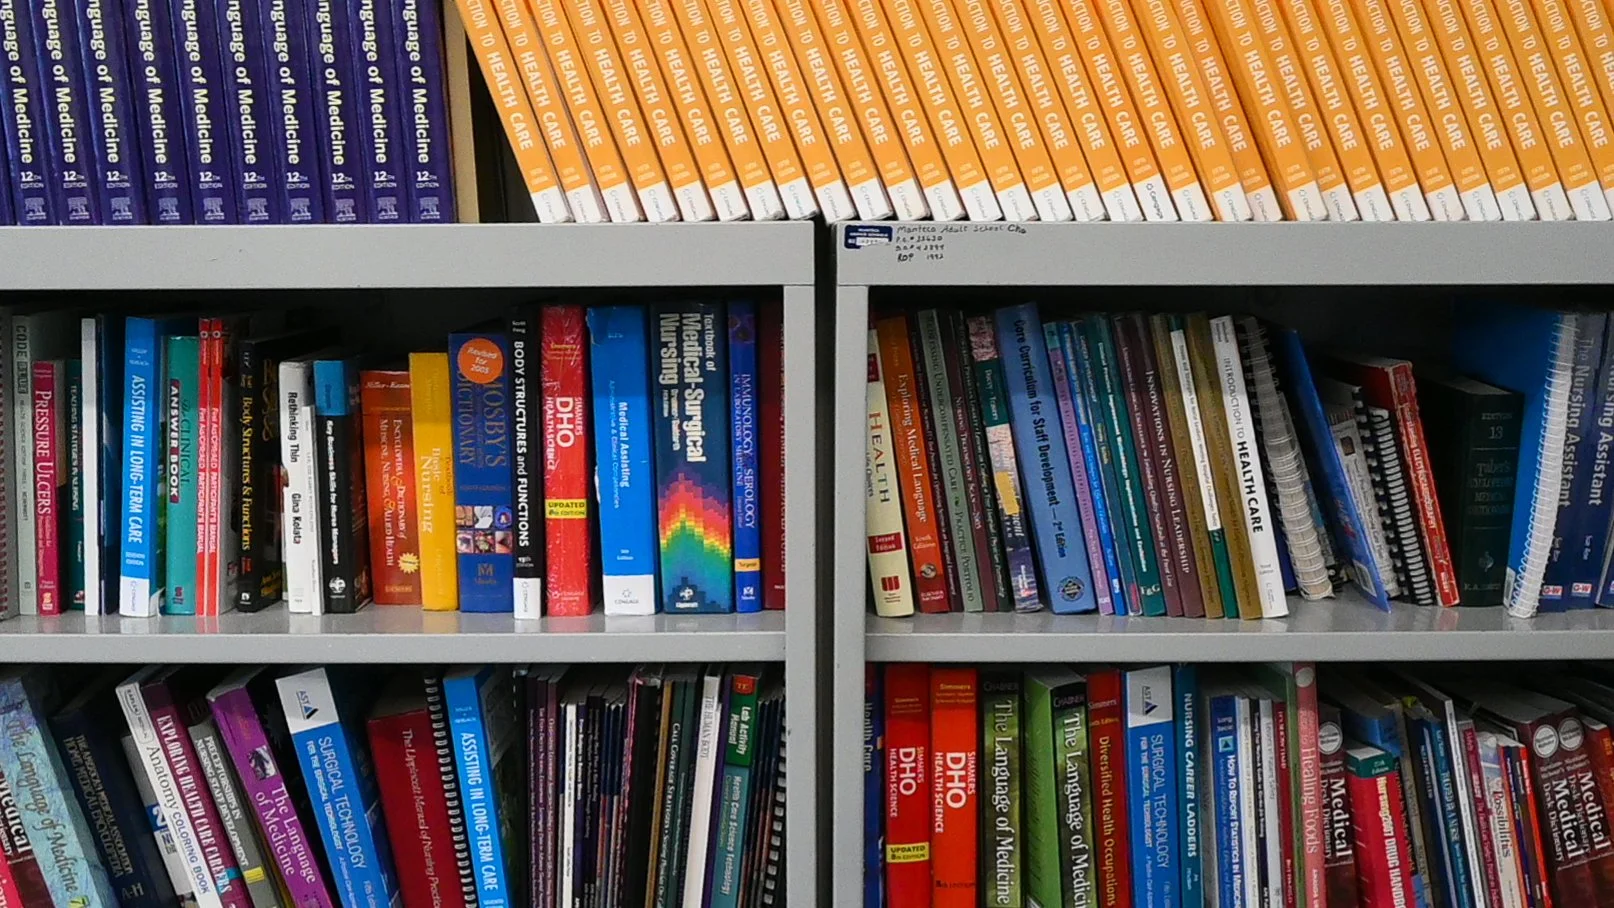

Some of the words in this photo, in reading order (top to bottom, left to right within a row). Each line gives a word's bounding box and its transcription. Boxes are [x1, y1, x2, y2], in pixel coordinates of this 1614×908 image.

[480, 30, 496, 47] TO
[1122, 32, 1136, 48] TO
[1306, 34, 1320, 50] TO
[1557, 34, 1571, 50] TO
[10, 66, 26, 83] of
[191, 66, 207, 84] of
[410, 66, 426, 84] of
[486, 52, 518, 108] HEALTH
[762, 28, 776, 44] TO
[769, 50, 800, 105] HEALTH
[792, 108, 816, 146] CARE
[1128, 53, 1159, 108] HEALTH
[1312, 55, 1342, 110] HEALTH
[1562, 53, 1594, 108] HEALTH
[13, 88, 33, 164] Medicine
[194, 88, 213, 164] Medicine
[412, 89, 430, 164] Medicine
[509, 112, 533, 150] CARE
[1152, 112, 1176, 149] CARE
[1334, 113, 1358, 152] CARE
[1585, 111, 1608, 148] CARE
[16, 325, 28, 358] CODE
[659, 314, 682, 385] Nursing
[704, 314, 716, 359] Textbook
[1014, 320, 1026, 343] Core
[1578, 338, 1594, 360] The
[514, 341, 525, 375] BODY
[706, 360, 716, 372] of
[1019, 344, 1036, 399] Curriculum
[131, 375, 145, 431] ASSISTING
[241, 397, 252, 424] Body
[682, 313, 706, 462] Medical-Surgical
[898, 374, 914, 428] Exploring
[1030, 401, 1042, 416] for
[1146, 370, 1165, 440] INNOVATIONS
[1224, 358, 1242, 426] INTRODUCTION
[1566, 364, 1590, 428] Nursing
[36, 390, 52, 458] PRESSURE
[170, 386, 179, 448] ANSWER
[288, 392, 299, 441] Rethinking
[515, 378, 528, 454] STRUCTURES
[556, 397, 574, 448] DHO
[618, 402, 628, 440] Medical
[742, 374, 753, 456] IMMUNOLOGY
[1033, 418, 1050, 442] Staff
[1236, 426, 1245, 439] TO
[1488, 426, 1503, 440] 13
[130, 436, 144, 447] IN
[242, 428, 252, 484] Structures
[290, 444, 300, 462] Thin
[516, 456, 528, 475] and
[620, 443, 630, 488] Assisting
[869, 412, 890, 503] HEALTH
[906, 428, 922, 468] Medical
[1159, 444, 1168, 456] IN
[36, 462, 54, 515] ULCERS
[129, 450, 144, 512] LONG-TERM
[170, 455, 178, 496] BOOK
[1038, 445, 1061, 506] Development
[1162, 458, 1177, 507] NURSING
[1237, 441, 1256, 496] HEALTH
[1558, 434, 1581, 508] Assistant
[1588, 431, 1614, 506] Assistant
[292, 493, 301, 512] Gina
[420, 456, 434, 533] Nursing
[518, 478, 529, 547] FUNCTIONS
[744, 468, 755, 528] SEROLOGY
[912, 472, 928, 522] Language
[1248, 497, 1264, 532] CARE
[128, 516, 142, 544] CARE
[242, 498, 252, 550] Functions
[293, 516, 302, 544] Kolata
[1172, 509, 1190, 574] LEADERSHIP
[386, 536, 395, 566] HEALTH
[962, 556, 974, 602] PORTFOLIO
[1572, 584, 1592, 593] G-W
[742, 706, 752, 722] Lab
[994, 700, 1014, 732] The
[1088, 698, 1118, 710] Simmers
[1184, 693, 1195, 748] NURSING
[6, 720, 32, 748] The
[728, 714, 740, 745] Manual
[736, 724, 751, 756] Activity
[1062, 712, 1082, 748] The
[460, 732, 483, 786] ASSISTING
[899, 748, 916, 796] DHO
[935, 752, 944, 791] HEALTH
[946, 752, 966, 808] DHO
[967, 752, 976, 795] SIMMERS
[991, 734, 1013, 814] Language
[1100, 736, 1114, 796] Diversified
[1150, 734, 1166, 792] SURGICAL
[1185, 750, 1196, 799] CAREER
[1301, 748, 1318, 805] Healing
[16, 751, 50, 816] Language
[157, 715, 190, 776] EXPLORING
[179, 776, 206, 818] HEALTH
[194, 818, 216, 846] CARE
[205, 847, 232, 894] CAREERS
[256, 792, 274, 806] of
[318, 736, 344, 794] SURGICAL
[336, 794, 367, 868] TECHNOLOGY
[470, 788, 485, 800] IN
[890, 784, 898, 818] SCIENCE
[1064, 751, 1084, 832] Language
[1229, 790, 1238, 820] REPORT
[1567, 776, 1580, 802] Desk
[147, 746, 178, 810] Anatomy
[172, 812, 198, 863] COLORING
[193, 866, 210, 894] BOOK
[272, 783, 289, 814] The
[284, 816, 316, 884] Language
[472, 802, 494, 863] LONG-TERM
[935, 792, 944, 833] SCIENCE
[995, 816, 1015, 834] of
[1101, 798, 1114, 836] Health
[1155, 794, 1170, 868] TECHNOLOGY
[1186, 801, 1197, 858] LADDERS
[1305, 806, 1318, 854] Foods
[1330, 778, 1353, 858] Medical
[1543, 783, 1552, 808] Desk
[1548, 809, 1564, 862] Dictionary
[1552, 779, 1585, 859] Medical
[1578, 772, 1612, 850] Medical
[263, 808, 295, 876] Medicine
[728, 819, 738, 852] Science
[890, 846, 926, 854] UPDATED
[1070, 835, 1088, 850] of
[1230, 822, 1239, 862] STATISTICS
[1384, 838, 1400, 868] DRUG
[47, 832, 79, 894] Medicine
[482, 865, 499, 892] CARE
[996, 836, 1015, 904] Medicine
[1104, 838, 1119, 907] Occupations
